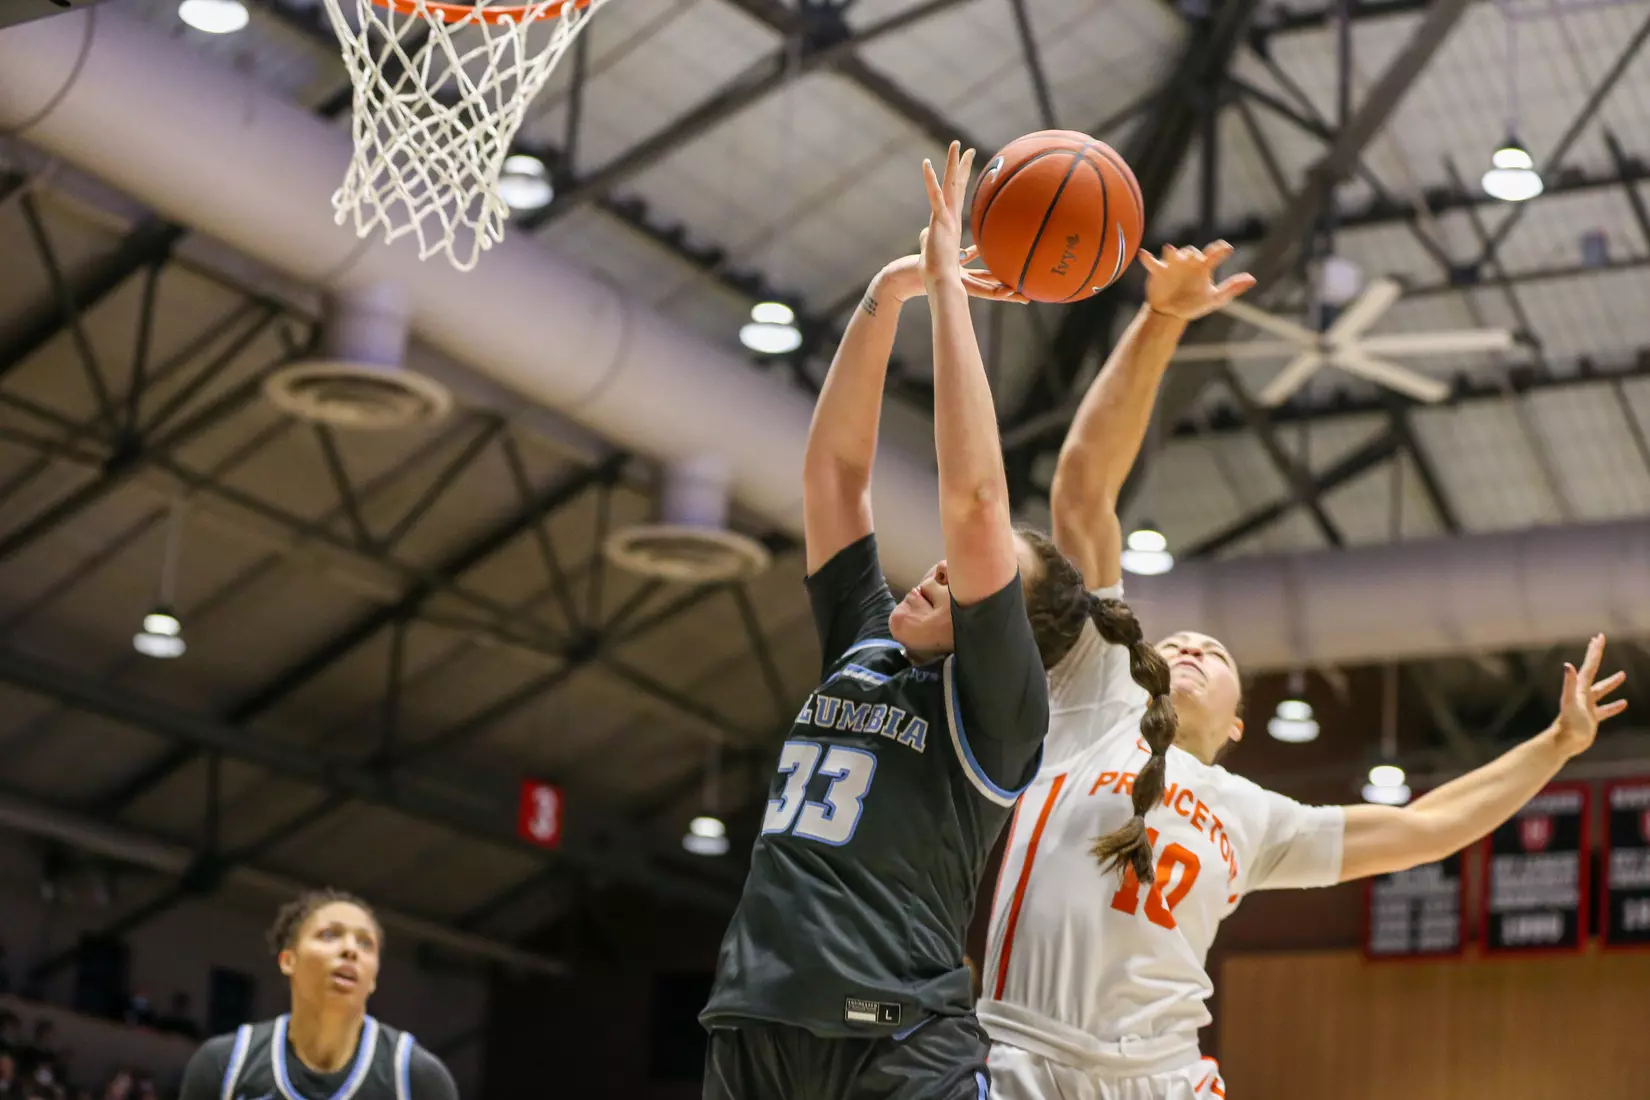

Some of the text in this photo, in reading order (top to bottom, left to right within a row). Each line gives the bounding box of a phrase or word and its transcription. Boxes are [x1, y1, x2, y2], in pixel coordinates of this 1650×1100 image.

[528, 785, 557, 840] 3
[761, 740, 877, 846] 33
[1088, 771, 1238, 882] PRNCETON
[1111, 827, 1201, 930] 10
[885, 1009, 893, 1021] L
